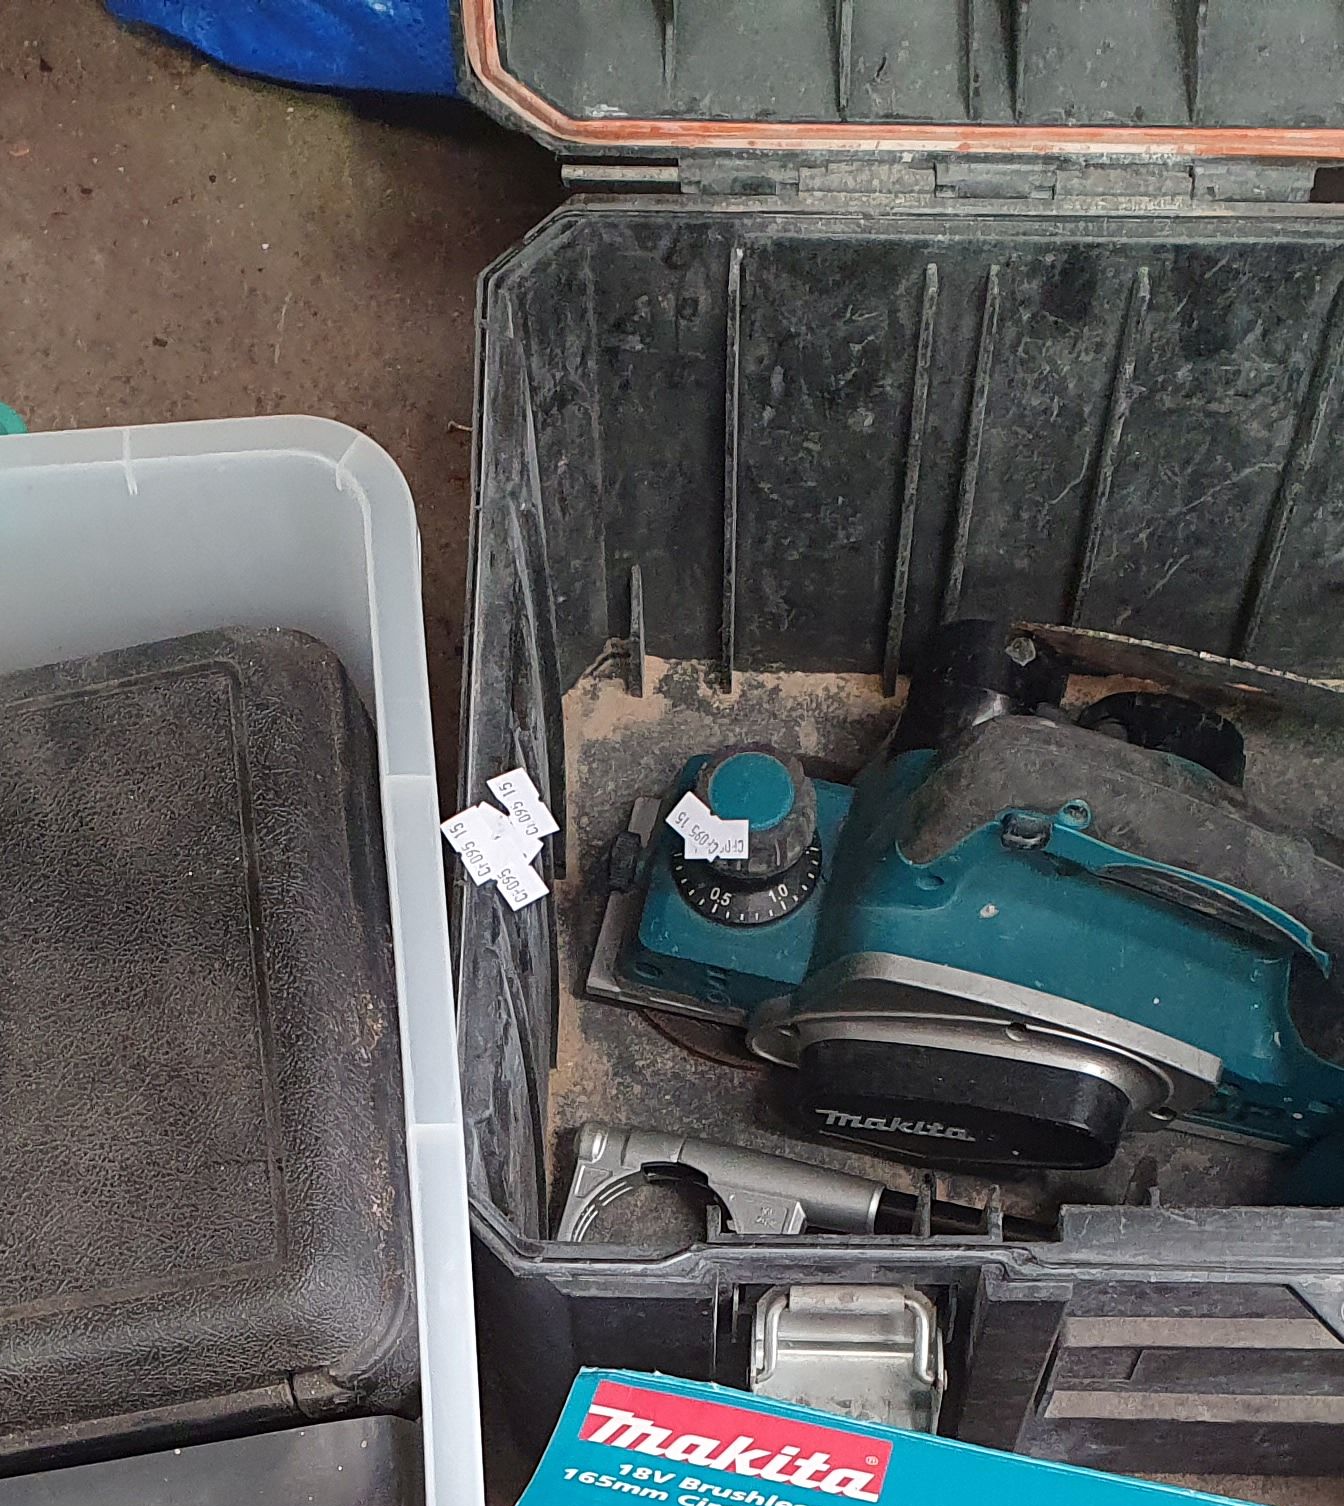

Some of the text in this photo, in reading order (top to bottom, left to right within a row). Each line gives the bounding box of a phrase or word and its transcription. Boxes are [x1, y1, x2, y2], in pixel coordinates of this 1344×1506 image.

[496, 779, 516, 798] 15
[674, 810, 689, 828] 15
[447, 820, 468, 840] 15
[707, 885, 733, 907] 0.5
[768, 883, 788, 903] 1.0
[586, 1405, 882, 1503] makita
[561, 1468, 668, 1502] 165mm
[617, 1462, 670, 1488] 18V
